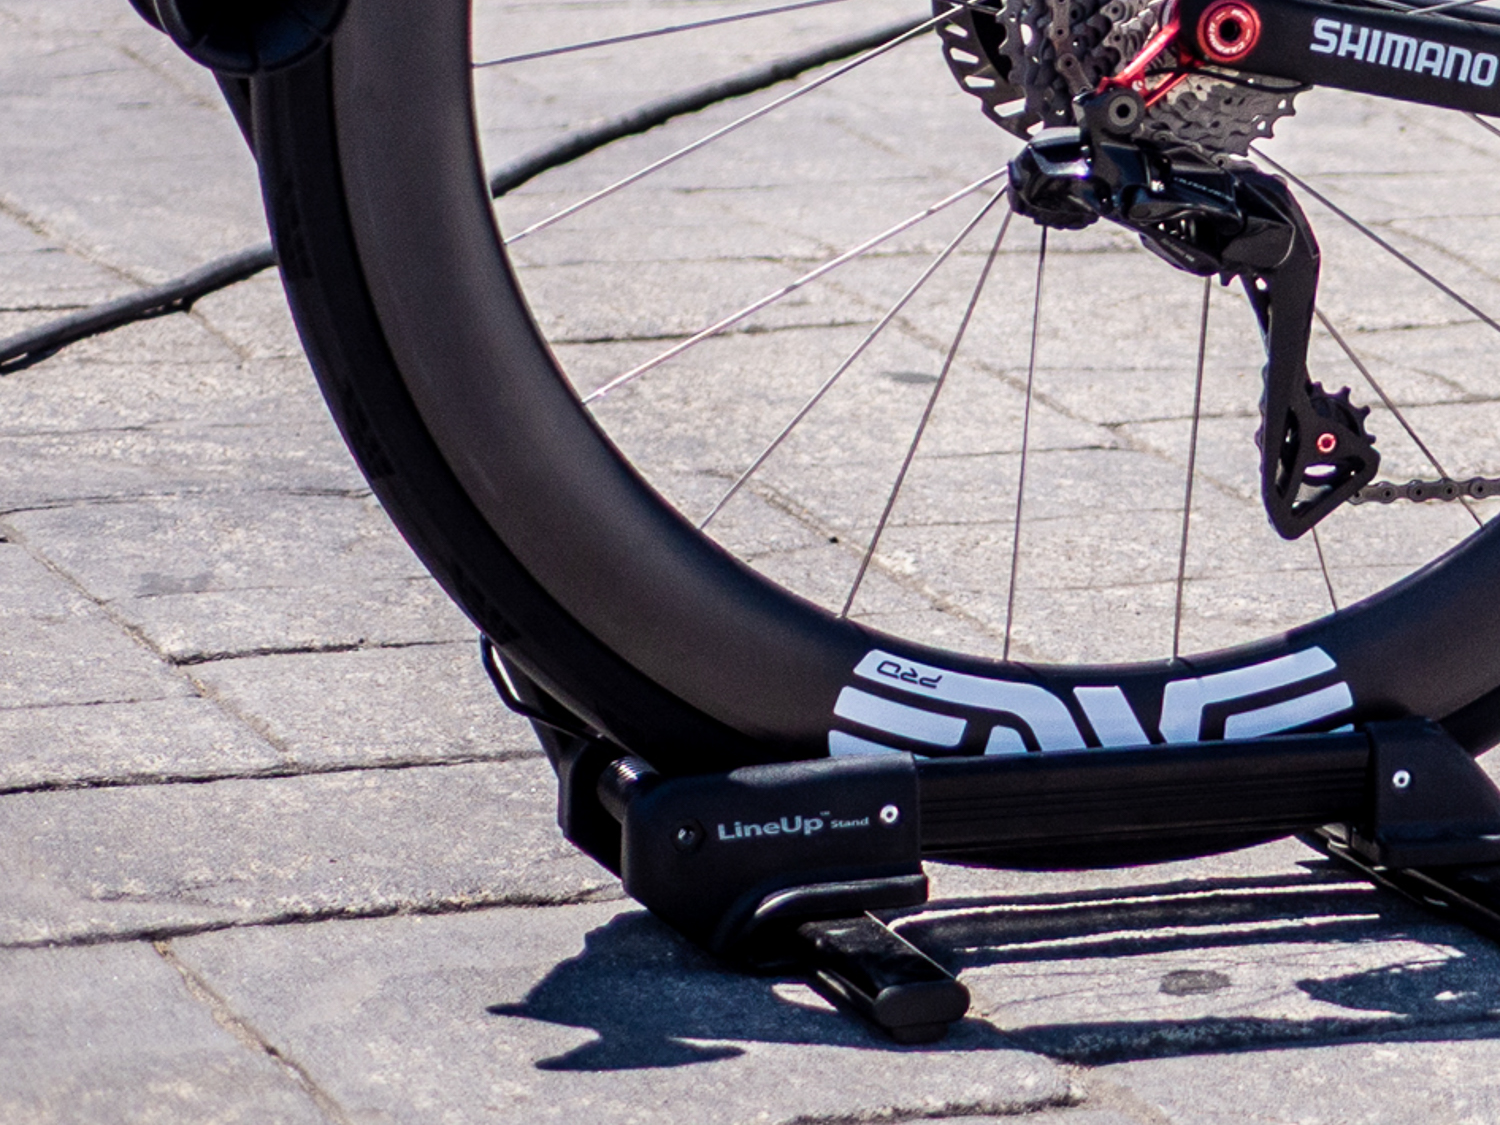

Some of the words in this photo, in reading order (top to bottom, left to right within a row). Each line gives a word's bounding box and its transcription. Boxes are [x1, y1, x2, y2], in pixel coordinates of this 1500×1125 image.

[1309, 17, 1499, 87] SHIMANO
[876, 659, 943, 689] PRO
[830, 816, 870, 830] Stand
